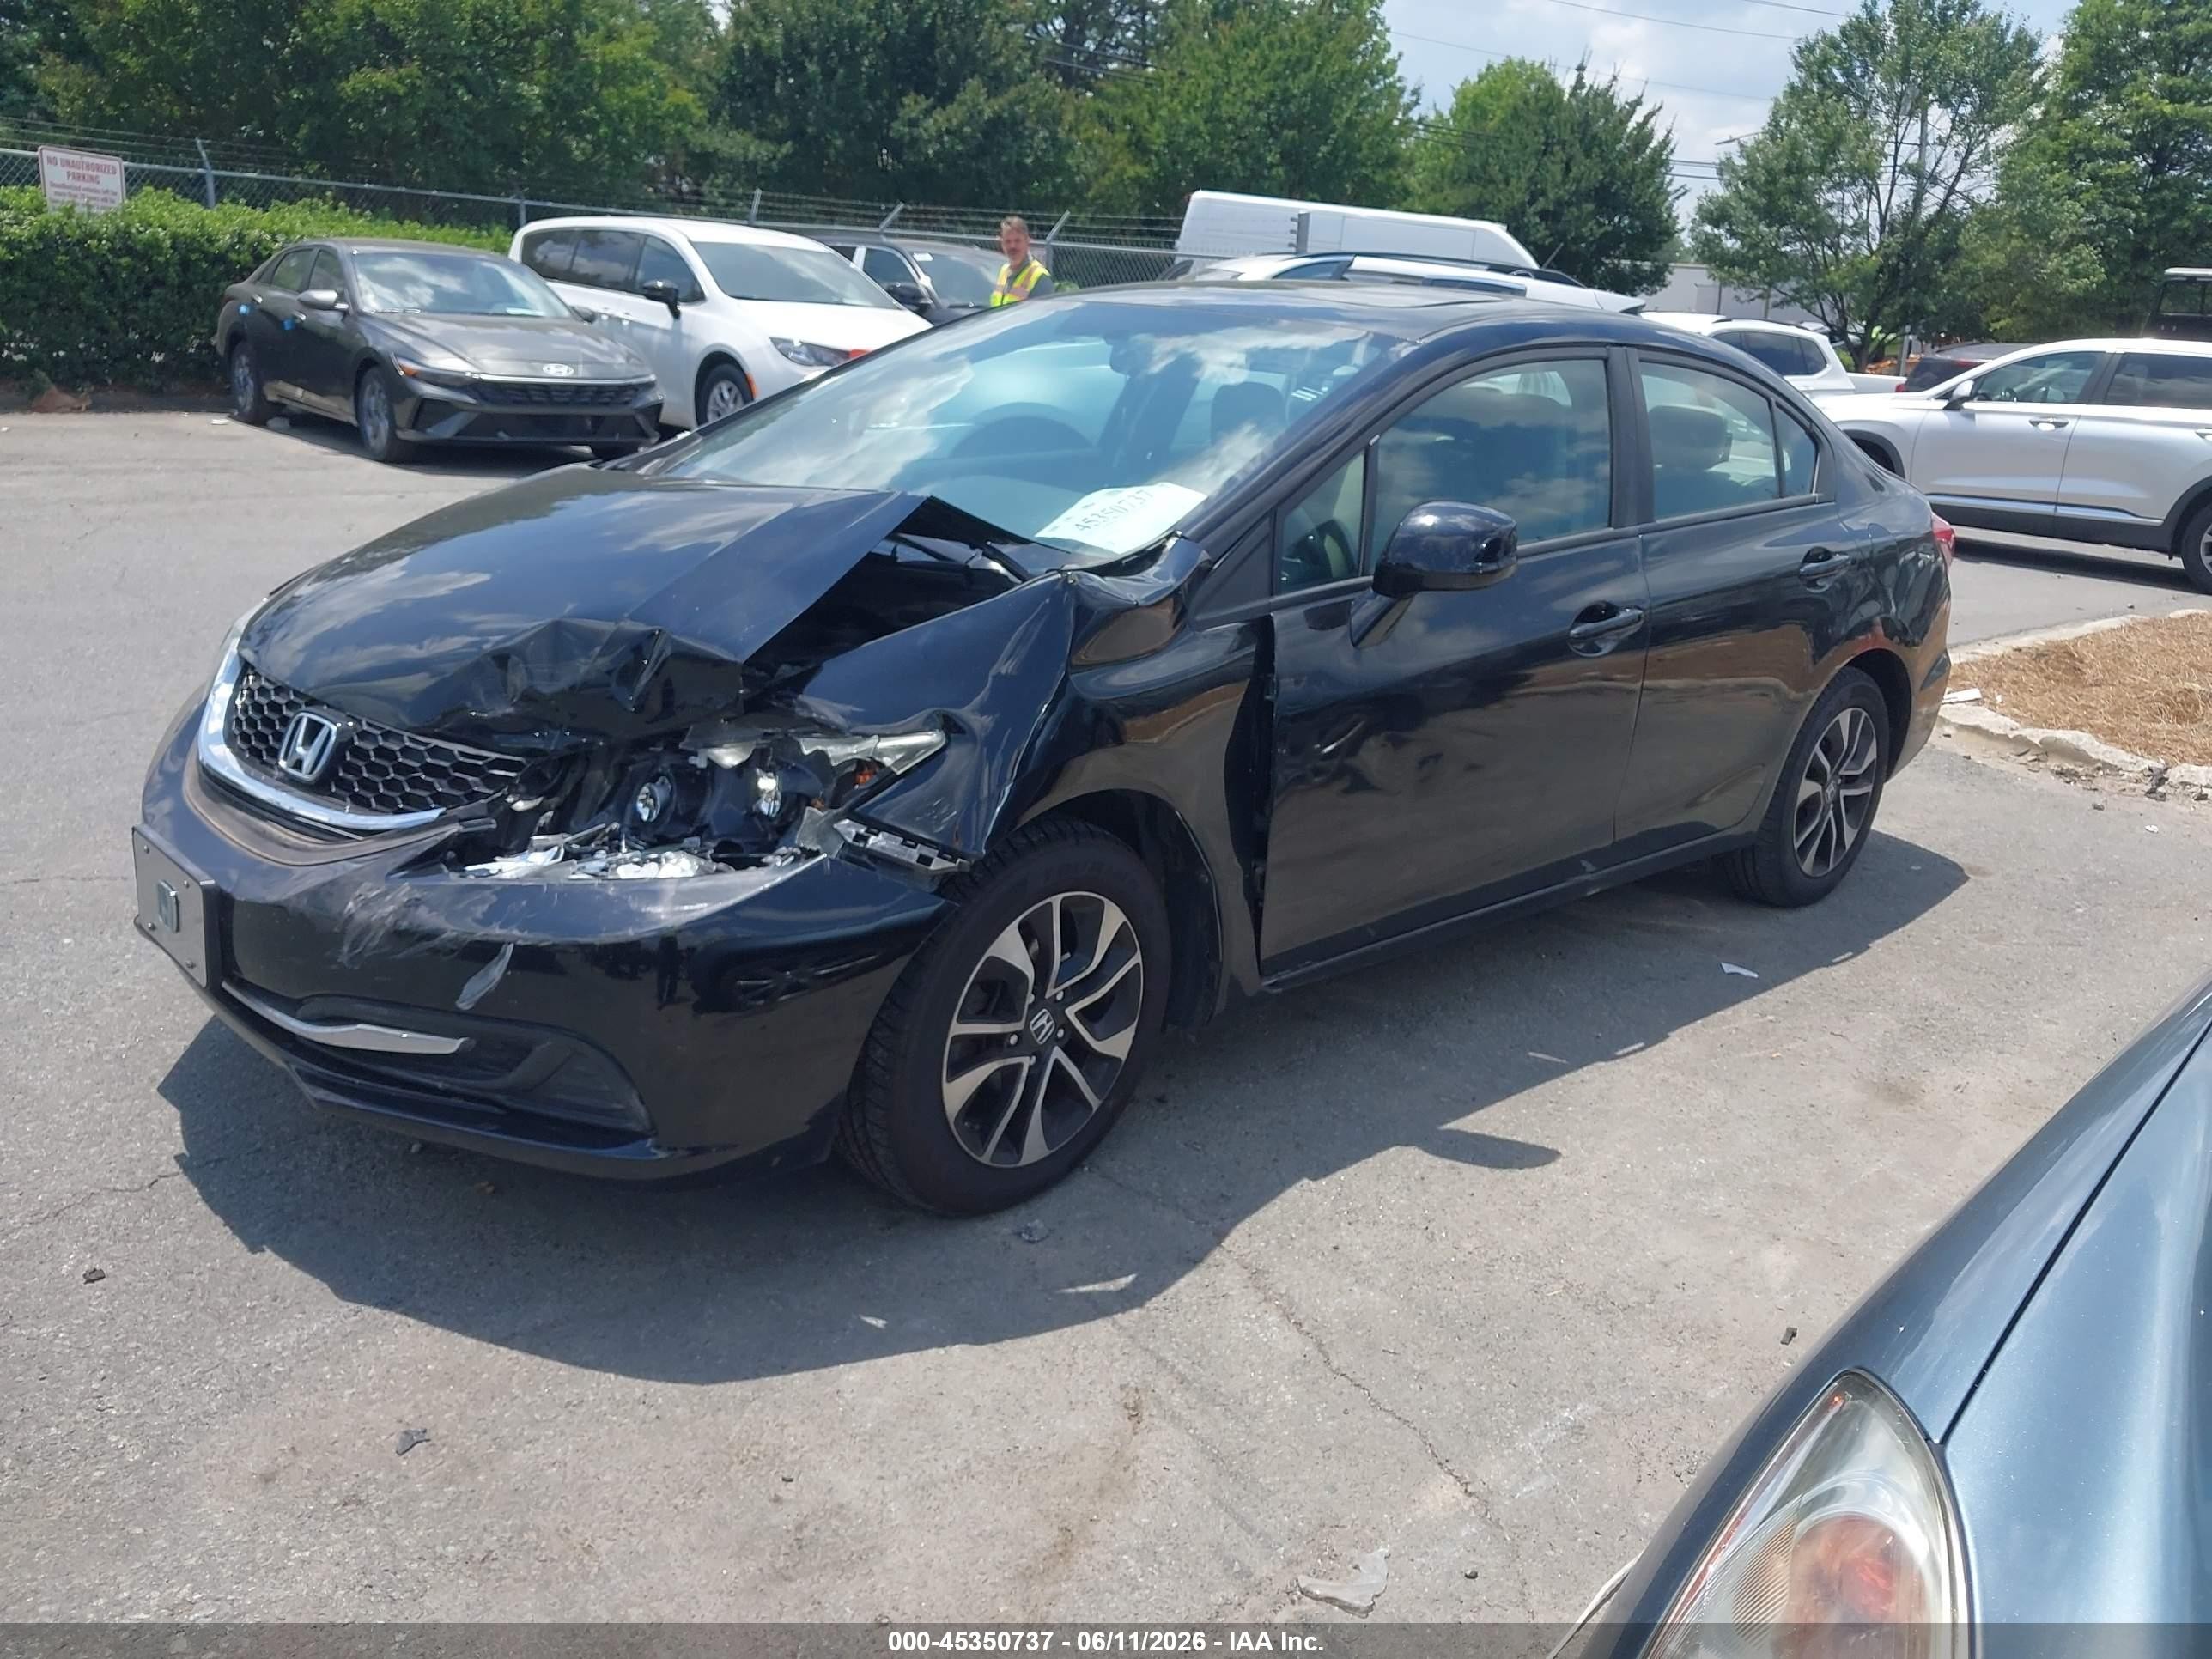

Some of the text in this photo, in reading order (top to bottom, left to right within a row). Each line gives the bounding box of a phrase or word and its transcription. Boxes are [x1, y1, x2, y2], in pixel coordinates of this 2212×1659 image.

[46, 155, 117, 175] NO UNAUTHORIZED
[1074, 489, 1154, 532] 45350737
